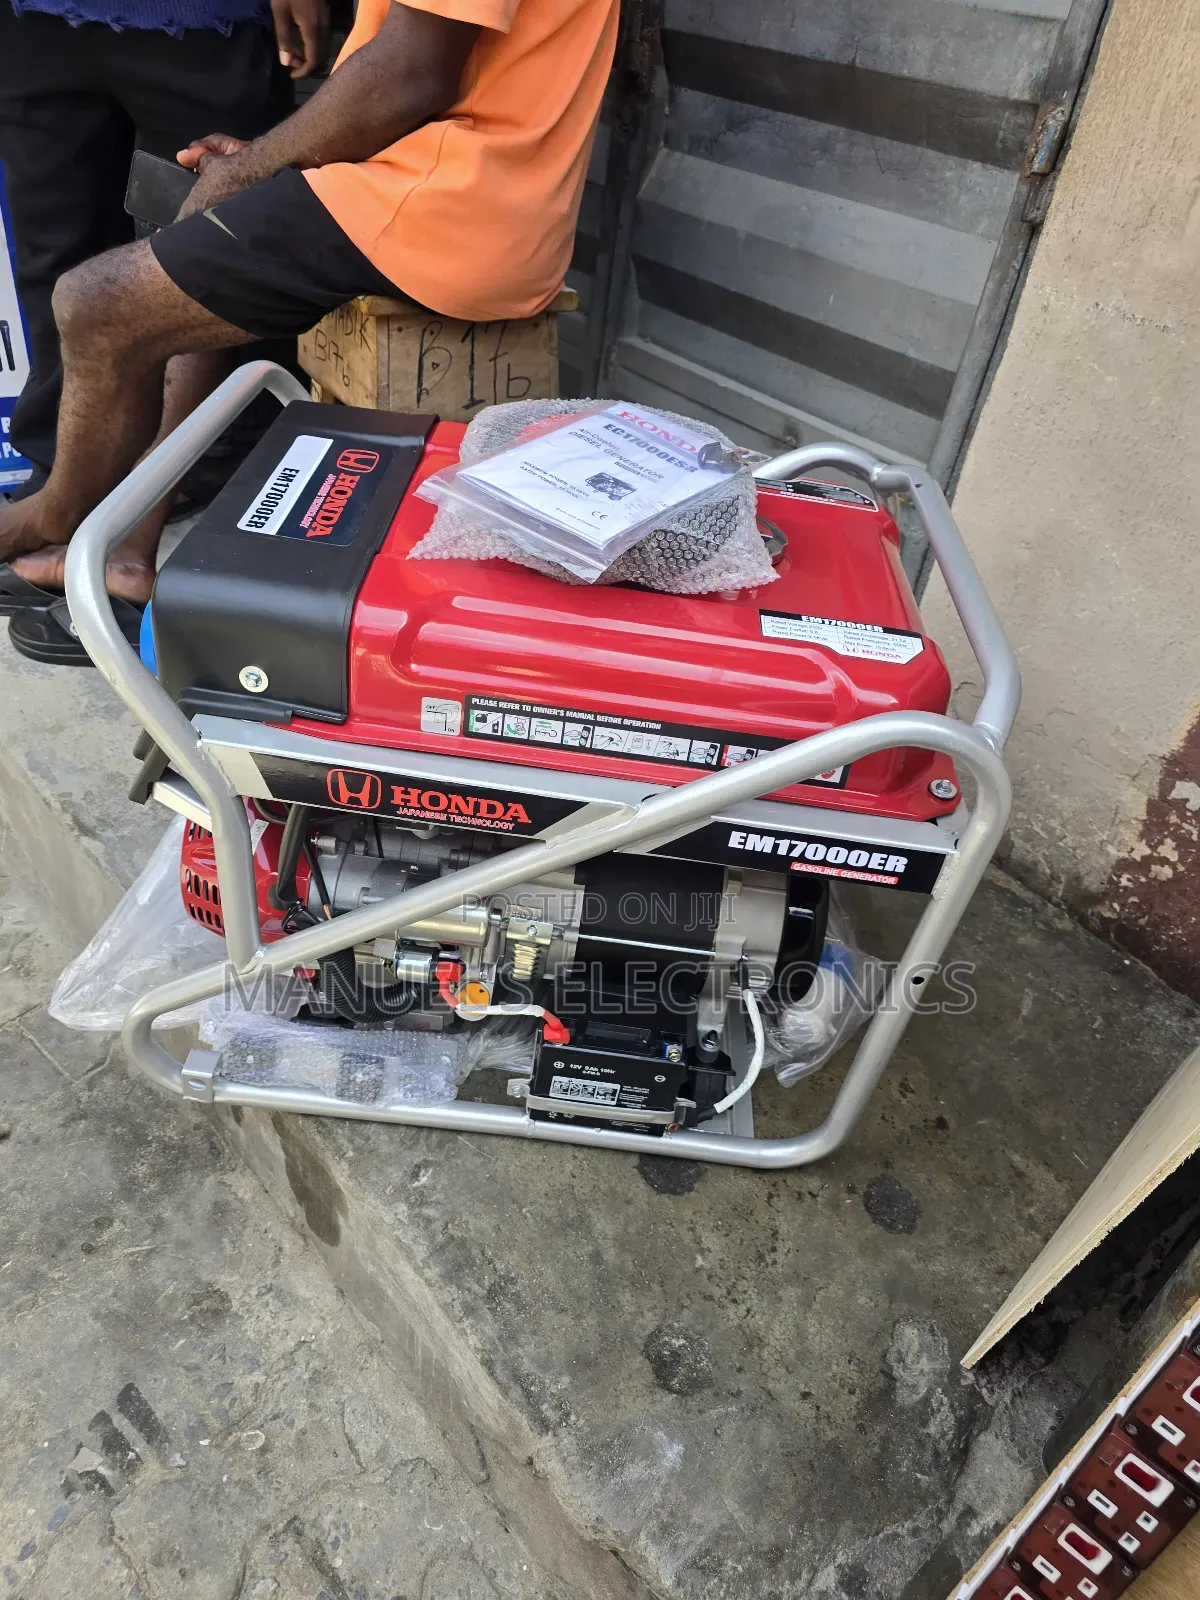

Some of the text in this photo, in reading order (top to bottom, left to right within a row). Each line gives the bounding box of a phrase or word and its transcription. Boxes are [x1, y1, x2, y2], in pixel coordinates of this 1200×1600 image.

[617, 410, 699, 455] HOND
[568, 431, 602, 450] DIESEL
[604, 447, 665, 480] GENERATOR
[245, 467, 301, 529] EM17000ER
[306, 472, 361, 537] HONDA
[801, 614, 884, 633] EM17000ER
[861, 648, 903, 660] HONDA
[471, 697, 662, 730] PLEASE REFER TO OWNER'S MANUAL BEFORE OPERATION
[390, 785, 532, 824] HONDA
[396, 806, 516, 832] JAPANESE TECHNOLOGY
[727, 830, 909, 873] EM17000ER
[793, 863, 897, 886] GASOLINE GENERATOR
